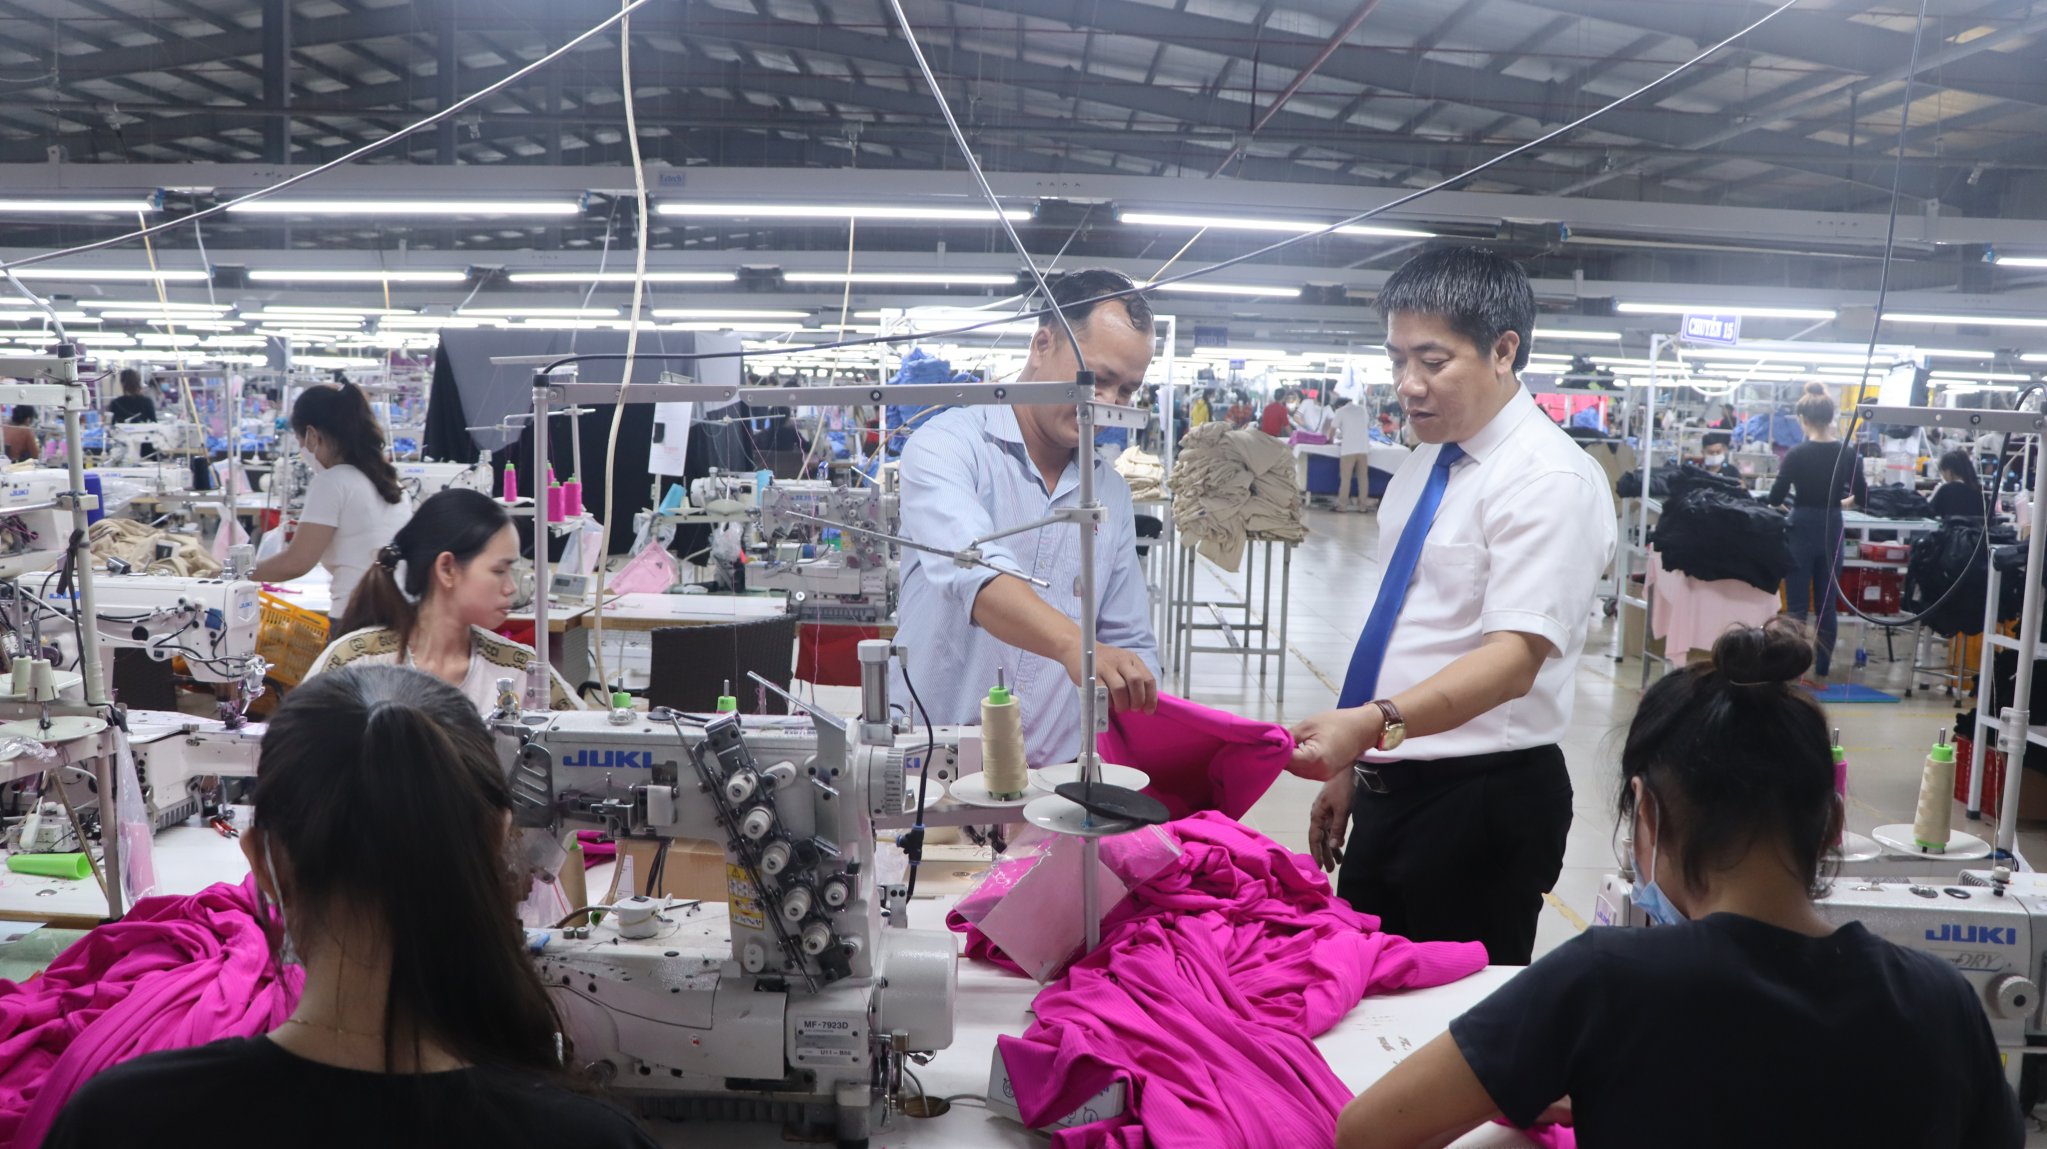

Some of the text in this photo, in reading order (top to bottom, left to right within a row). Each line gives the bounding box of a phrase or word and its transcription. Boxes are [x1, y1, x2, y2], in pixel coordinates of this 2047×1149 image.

[1723, 322, 1734, 339] 15
[563, 749, 652, 768] JUKI
[906, 756, 920, 768] KI
[1925, 924, 2016, 945] JUKI
[804, 1020, 849, 1030] MF-7923D
